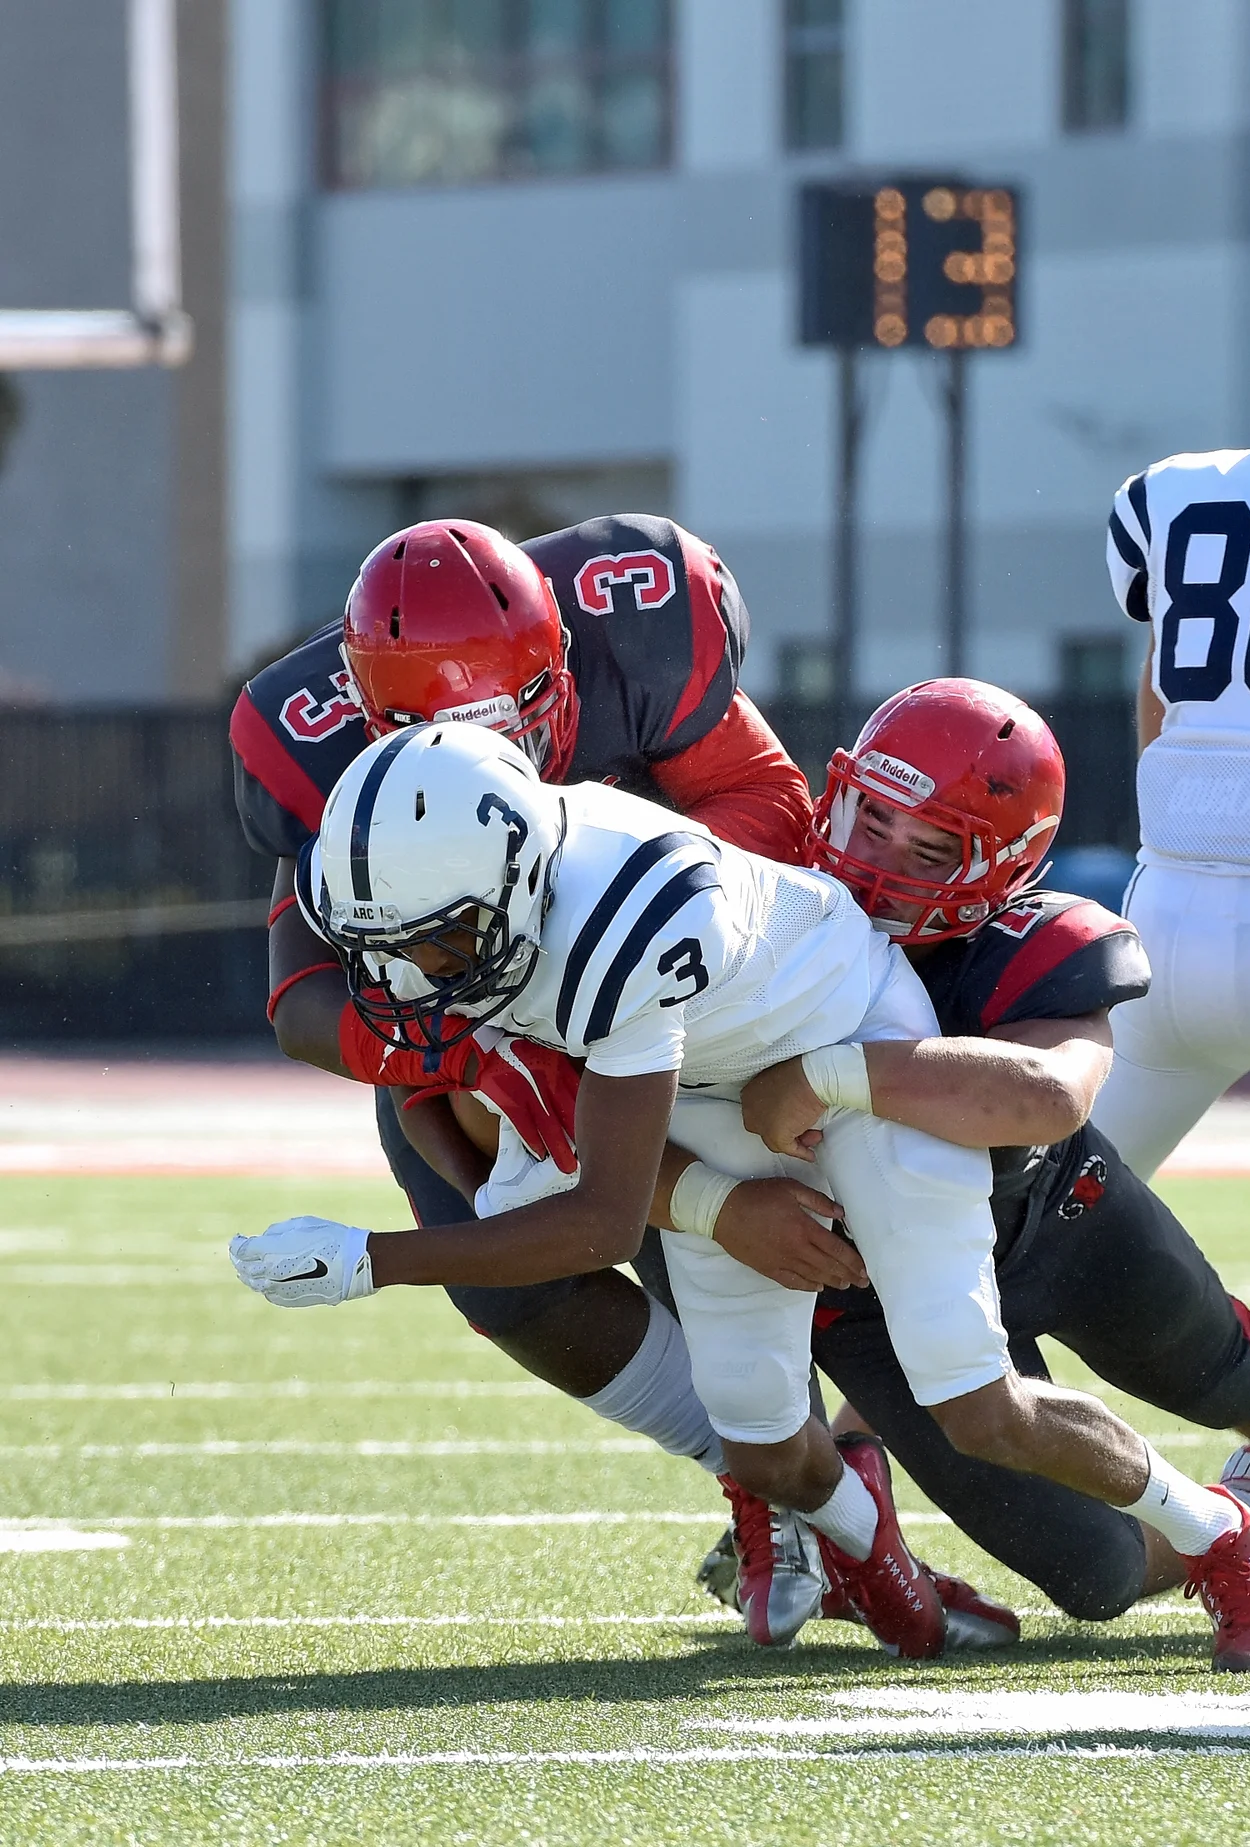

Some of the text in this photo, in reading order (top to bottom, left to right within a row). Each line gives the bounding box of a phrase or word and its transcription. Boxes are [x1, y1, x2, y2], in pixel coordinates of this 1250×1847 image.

[873, 186, 1015, 347] 13
[573, 548, 677, 617] 3
[394, 712, 411, 723] NIKE
[452, 703, 497, 722] Riddell
[880, 759, 919, 786] Riddell
[476, 792, 529, 854] 3
[353, 906, 375, 920] ARC
[656, 937, 710, 1008] 3
